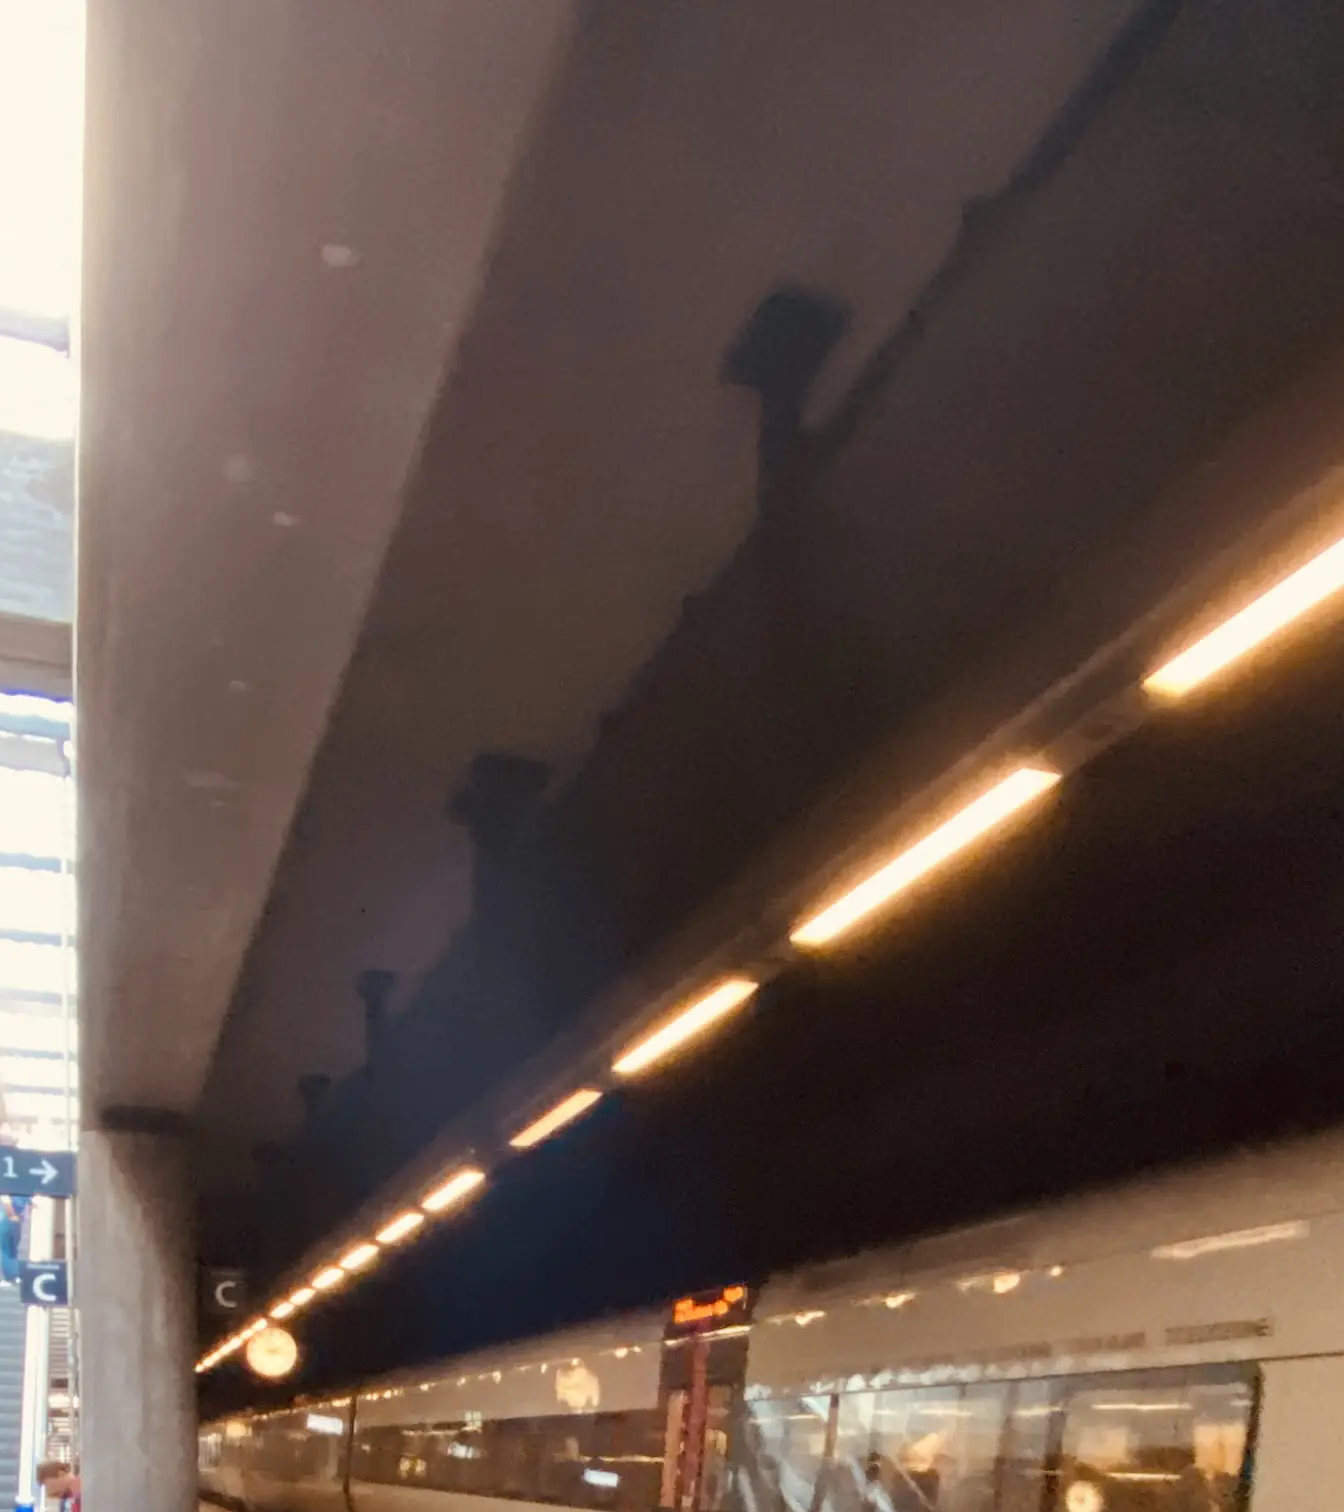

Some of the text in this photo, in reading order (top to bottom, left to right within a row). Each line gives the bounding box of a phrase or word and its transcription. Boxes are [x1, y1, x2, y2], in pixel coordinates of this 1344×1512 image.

[1, 1155, 19, 1179] 1
[32, 1272, 58, 1302] C
[214, 1280, 238, 1308] C
